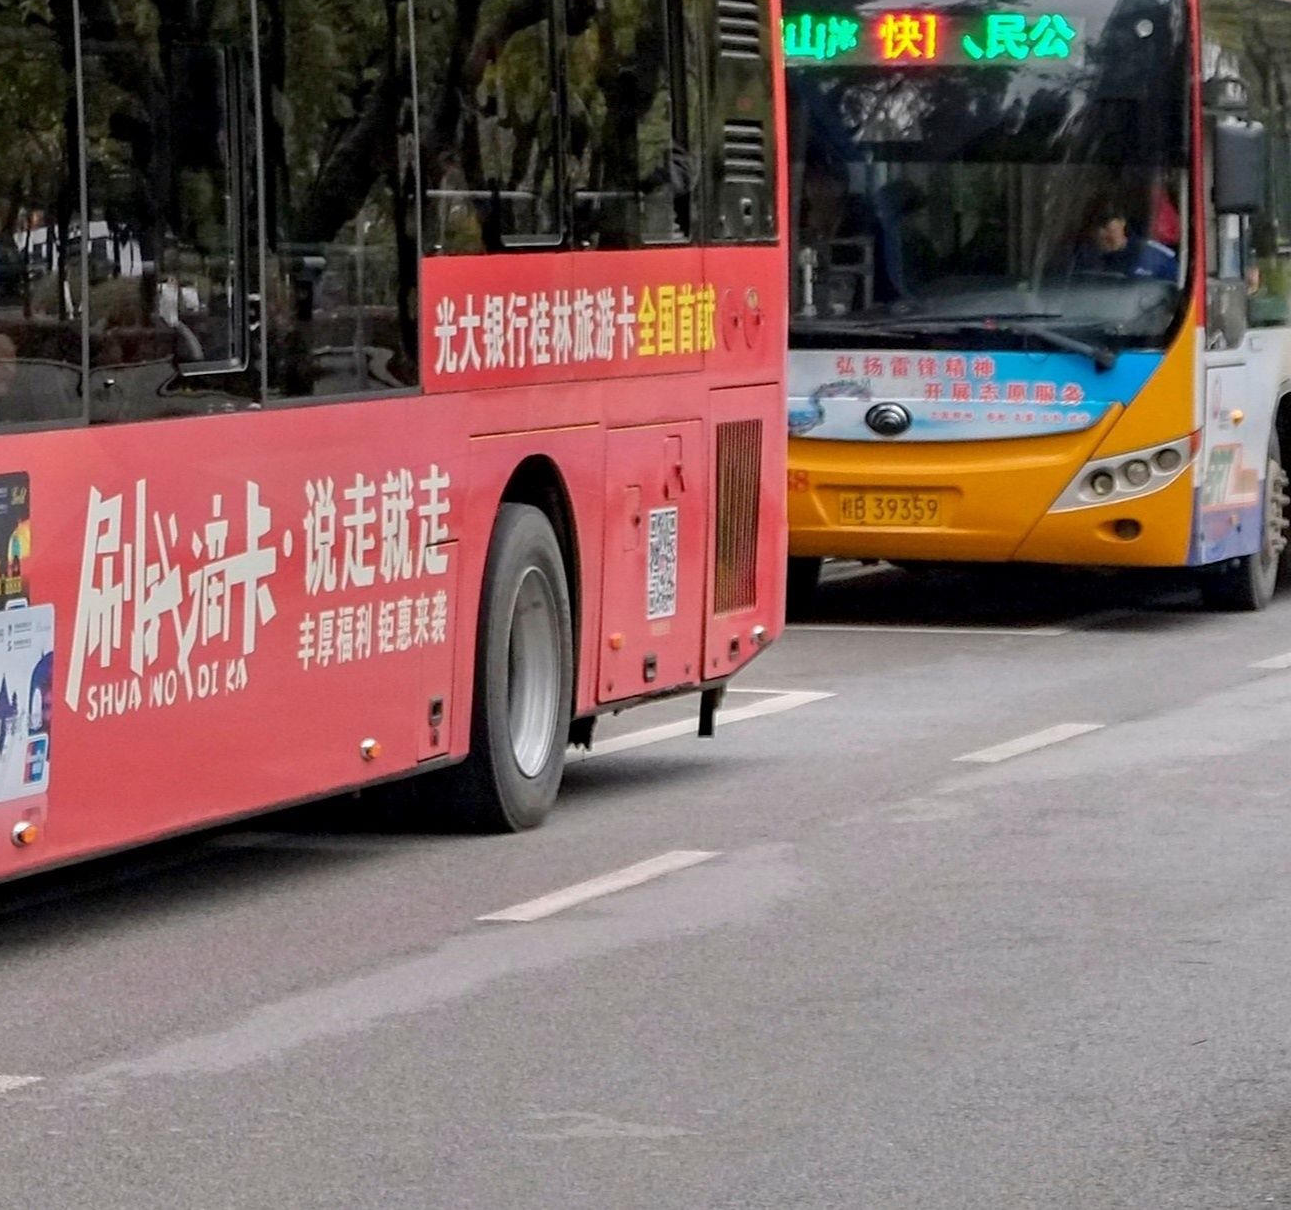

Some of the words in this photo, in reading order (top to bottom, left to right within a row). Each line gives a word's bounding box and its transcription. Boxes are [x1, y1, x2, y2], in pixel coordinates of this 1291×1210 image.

[434, 285, 636, 374] 光大银行桂林旅游卡
[836, 355, 995, 378] 弘扬雷锋精神
[297, 602, 371, 671] 丰厚福利
[377, 590, 447, 654] 钜惠来袭
[85, 677, 142, 721] SHUA
[197, 659, 220, 699] DI
[225, 657, 250, 696] KA
